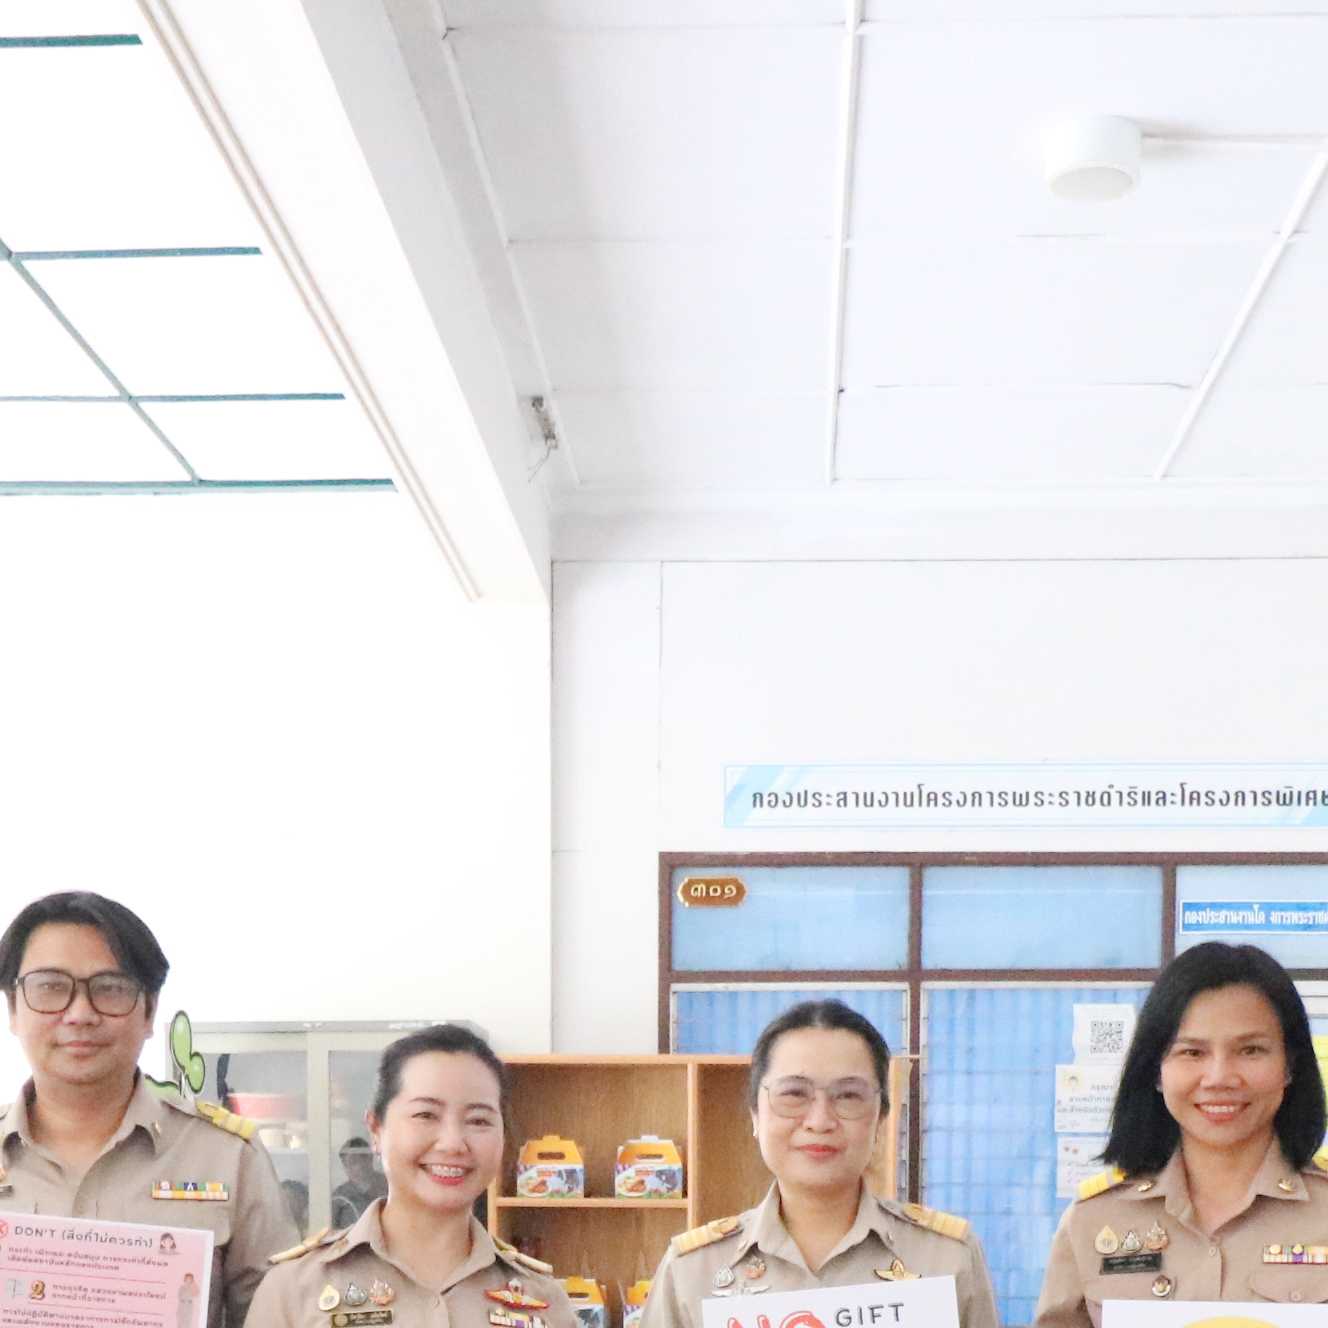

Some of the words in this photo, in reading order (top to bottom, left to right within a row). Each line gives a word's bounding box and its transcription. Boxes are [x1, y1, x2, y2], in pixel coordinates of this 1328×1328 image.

[691, 883, 737, 899] ๓๐๑
[29, 1280, 46, 1301] 2
[834, 1302, 906, 1328] GIFT
